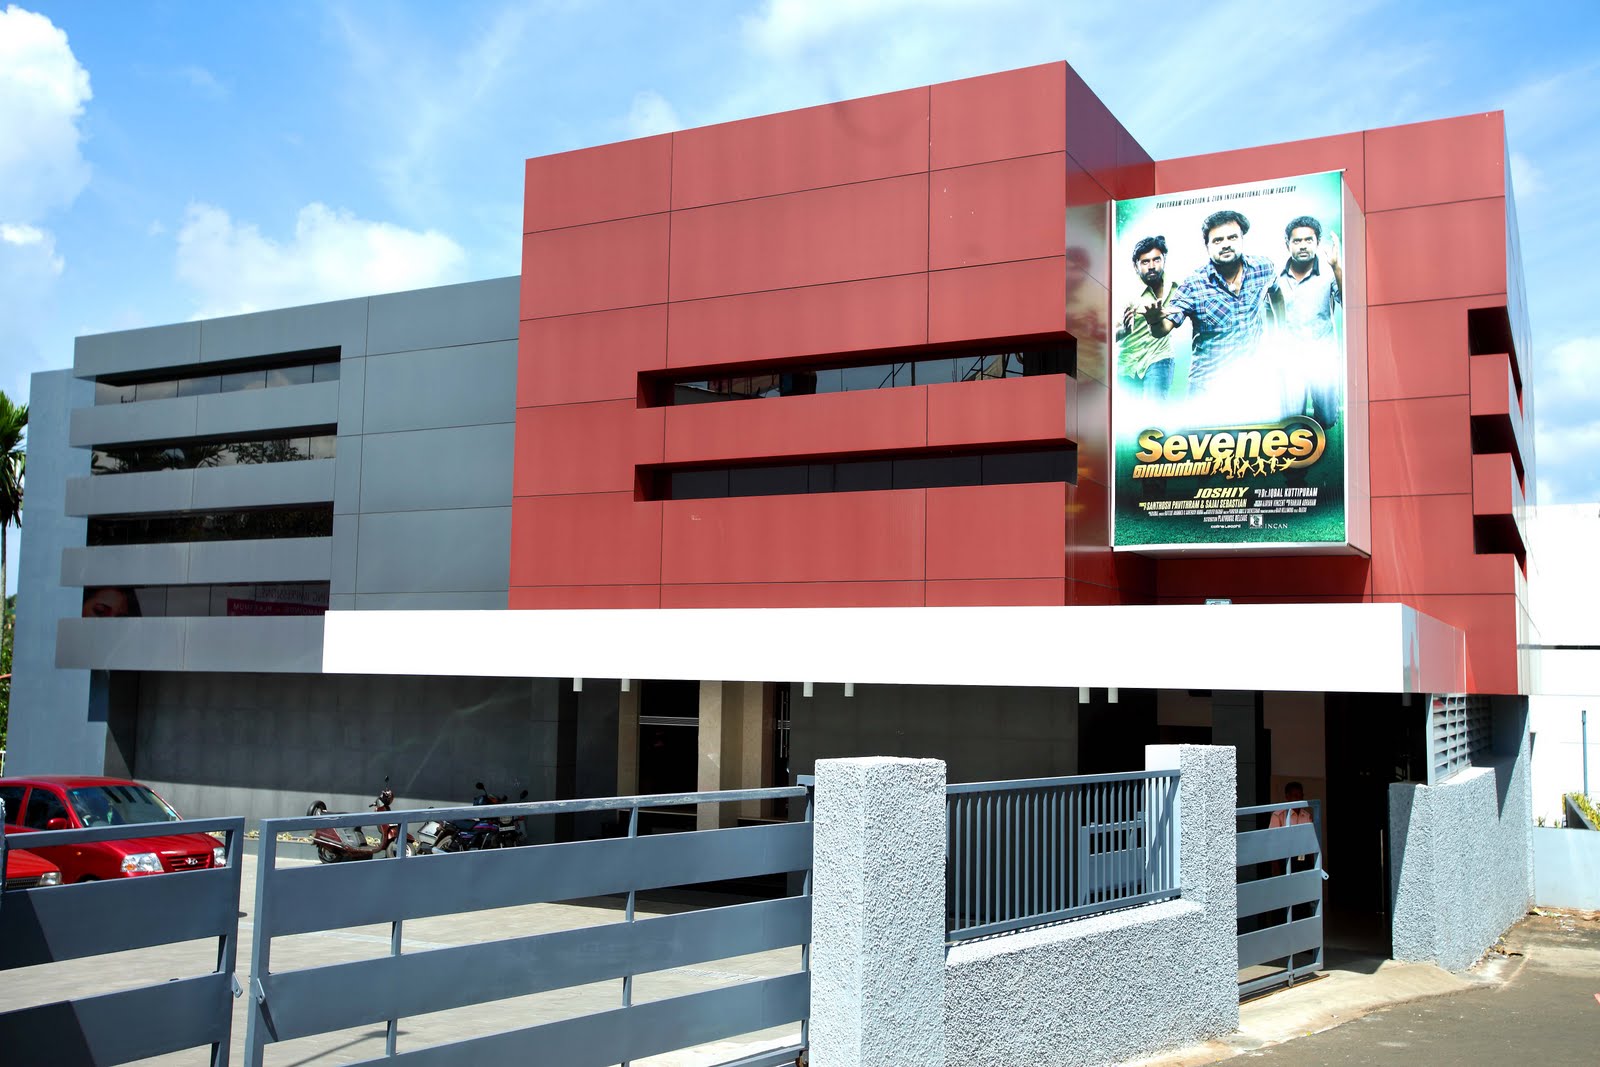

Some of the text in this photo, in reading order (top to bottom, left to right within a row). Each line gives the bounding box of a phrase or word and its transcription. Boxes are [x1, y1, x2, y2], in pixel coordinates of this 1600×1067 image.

[1156, 200, 1182, 209] PAVITHRAM
[1183, 197, 1205, 206] CREATION
[1224, 189, 1261, 201] INTERNATIONAL
[1262, 188, 1275, 196] FILM
[1275, 185, 1297, 195] FACTORY
[1135, 428, 1314, 463] Sevenes
[1193, 487, 1250, 499] JOSHIY
[1146, 501, 1171, 511] SANTHOSH
[1200, 500, 1205, 509] &
[1219, 499, 1248, 509] SEBASTIAN
